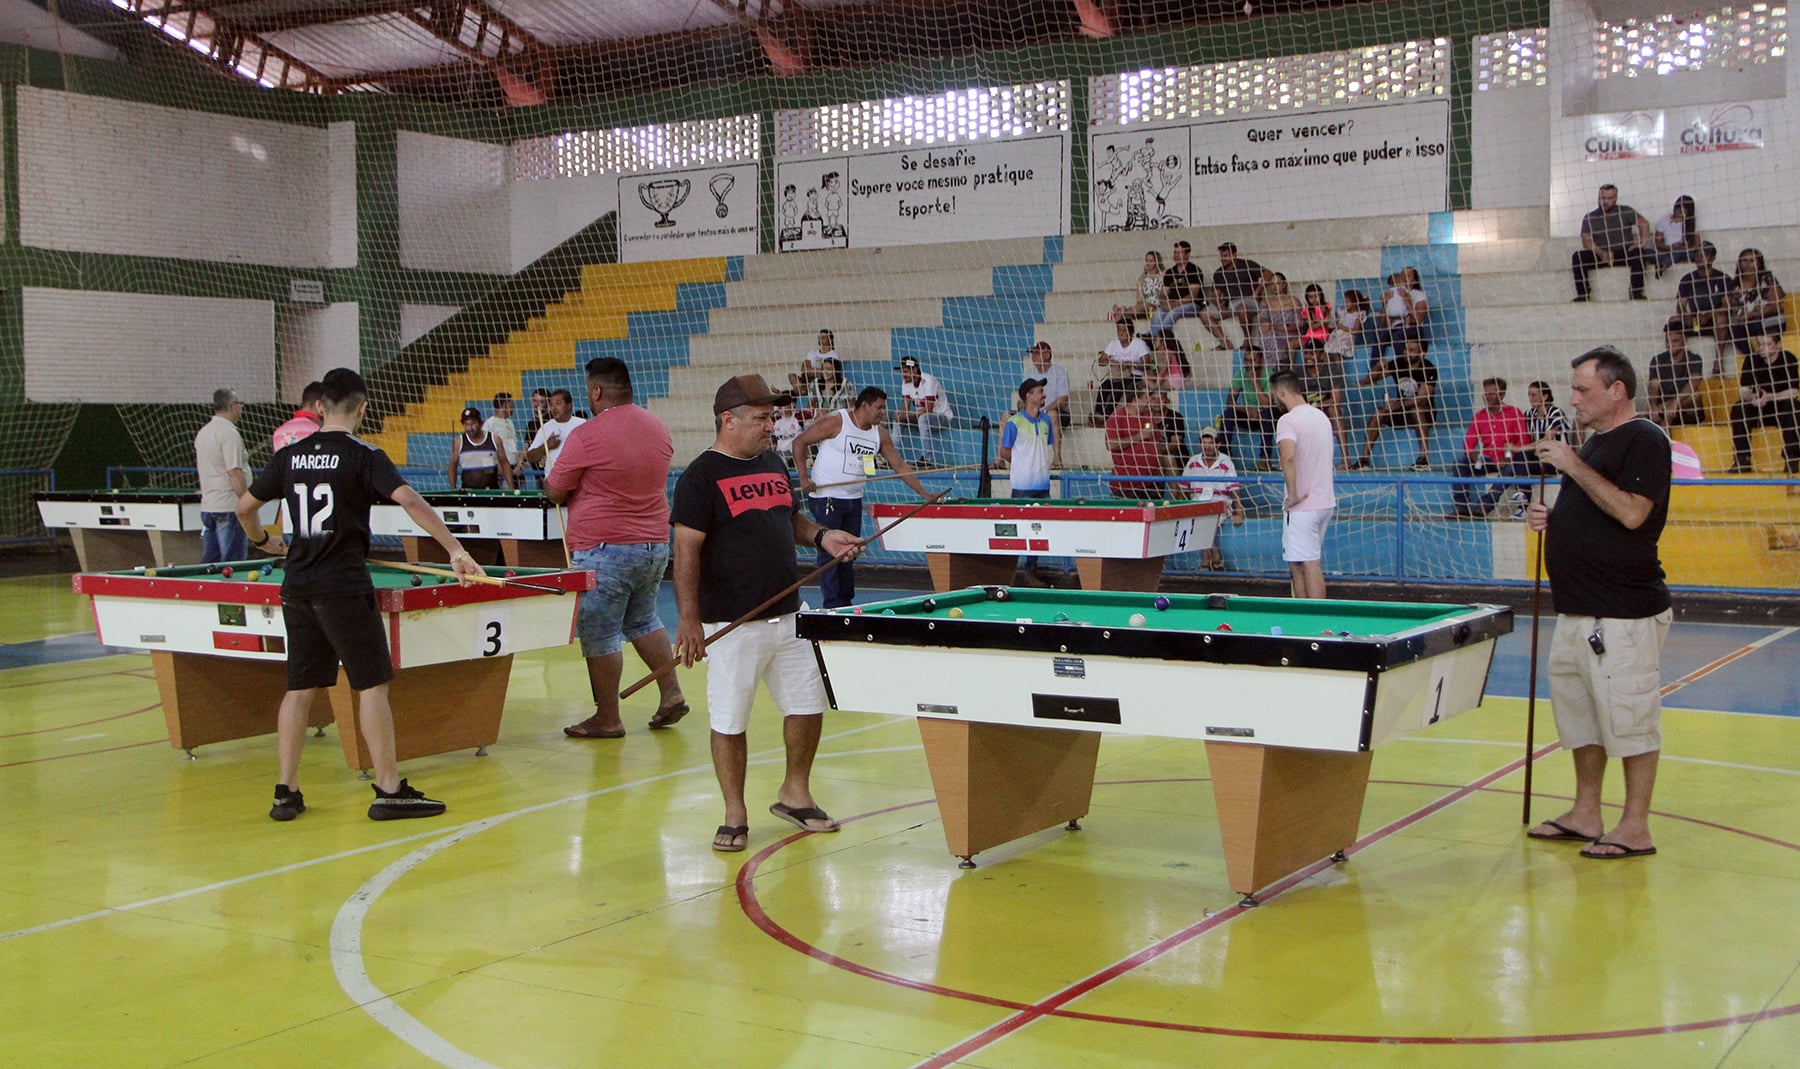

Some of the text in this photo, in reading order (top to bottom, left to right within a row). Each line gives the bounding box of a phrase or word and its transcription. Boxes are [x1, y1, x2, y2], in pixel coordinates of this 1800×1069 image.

[1247, 120, 1354, 142] Quer vencer?
[901, 149, 976, 170] Se desafie
[1231, 153, 1259, 173] faça
[1262, 159, 1270, 169] o
[1333, 150, 1357, 166] que
[1363, 141, 1402, 165] puder
[1416, 136, 1445, 157] isso
[851, 179, 892, 198] Supere
[928, 175, 967, 189] mesmo
[974, 164, 1034, 190] pratique
[898, 195, 956, 219] Esporte!
[291, 454, 340, 470] MARCELO
[293, 482, 335, 538] 12
[1178, 529, 1187, 551] 4
[482, 620, 502, 657] 3
[1428, 675, 1444, 725] 1
